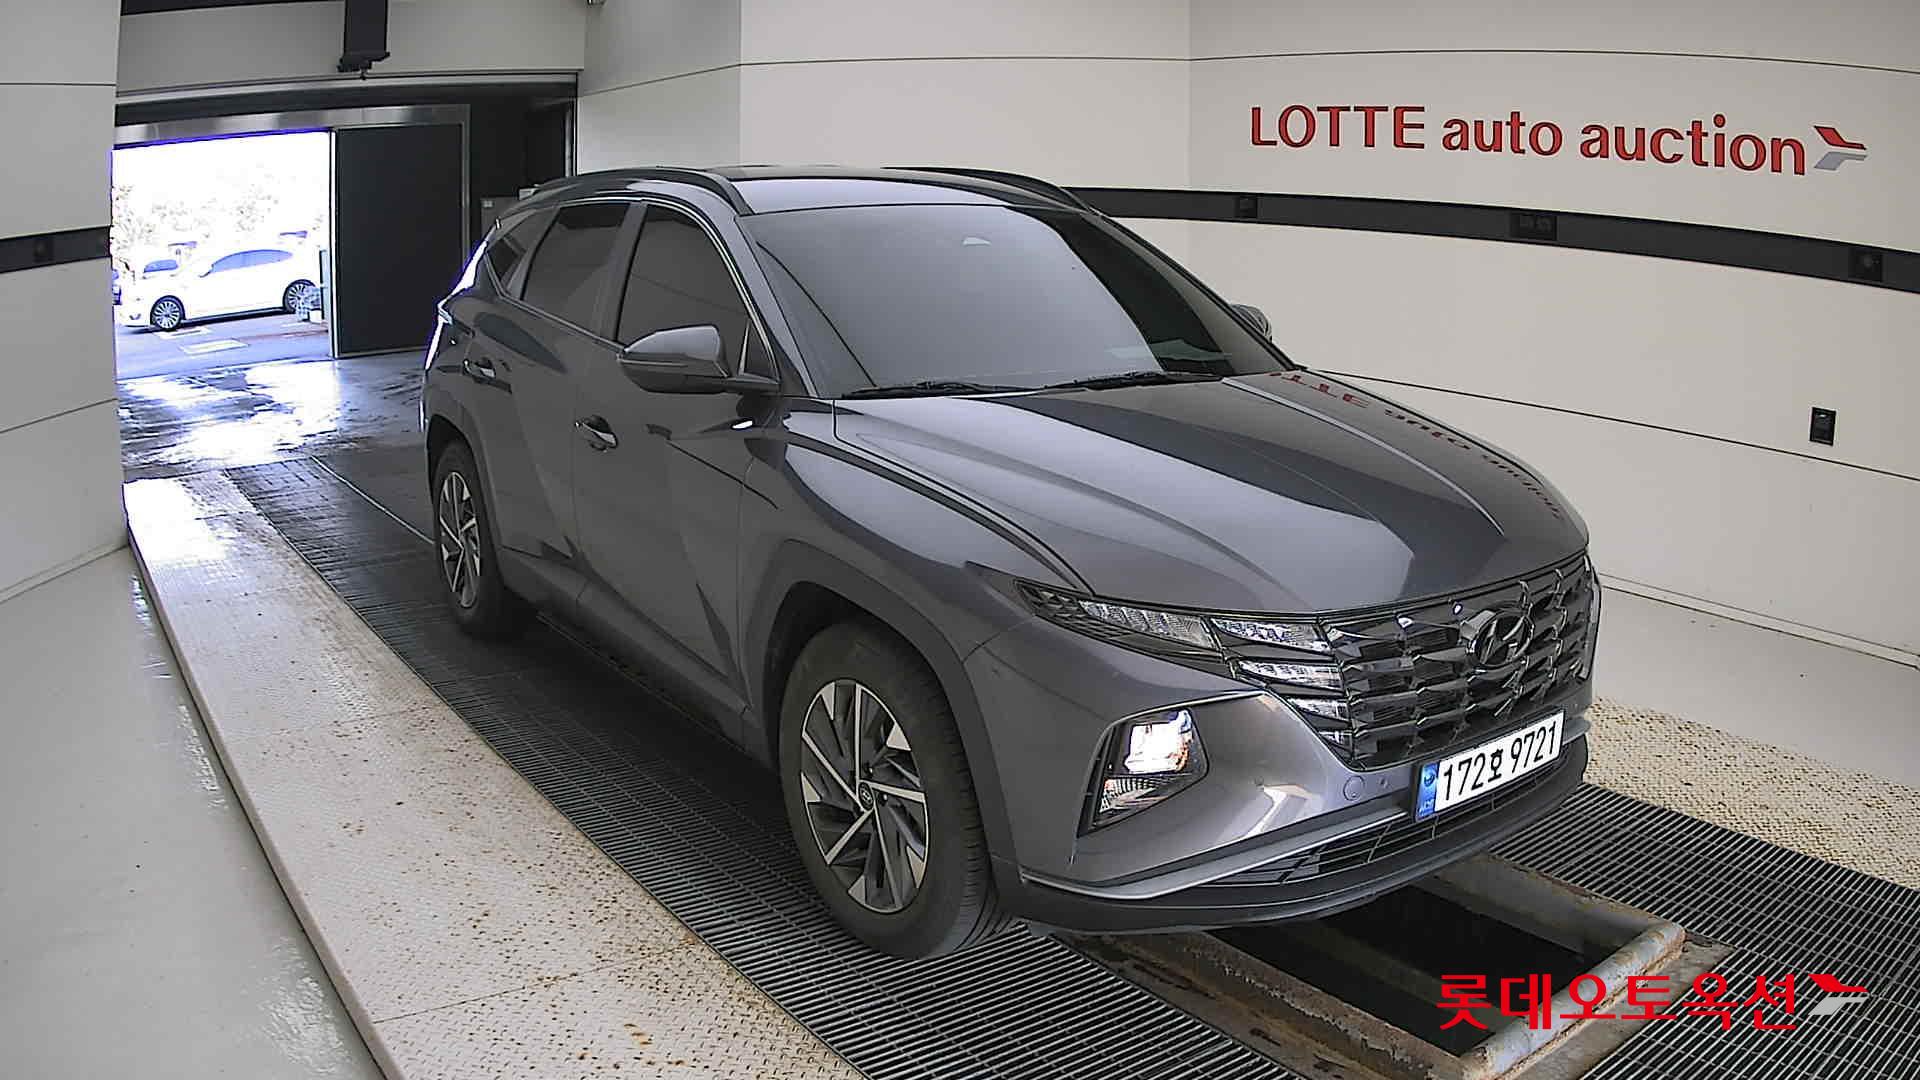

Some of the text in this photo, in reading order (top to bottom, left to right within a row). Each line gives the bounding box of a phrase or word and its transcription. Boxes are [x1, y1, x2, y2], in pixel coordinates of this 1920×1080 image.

[1251, 104, 1806, 176] LOTTE auto auction
[1443, 720, 1557, 801] 172호 9721
